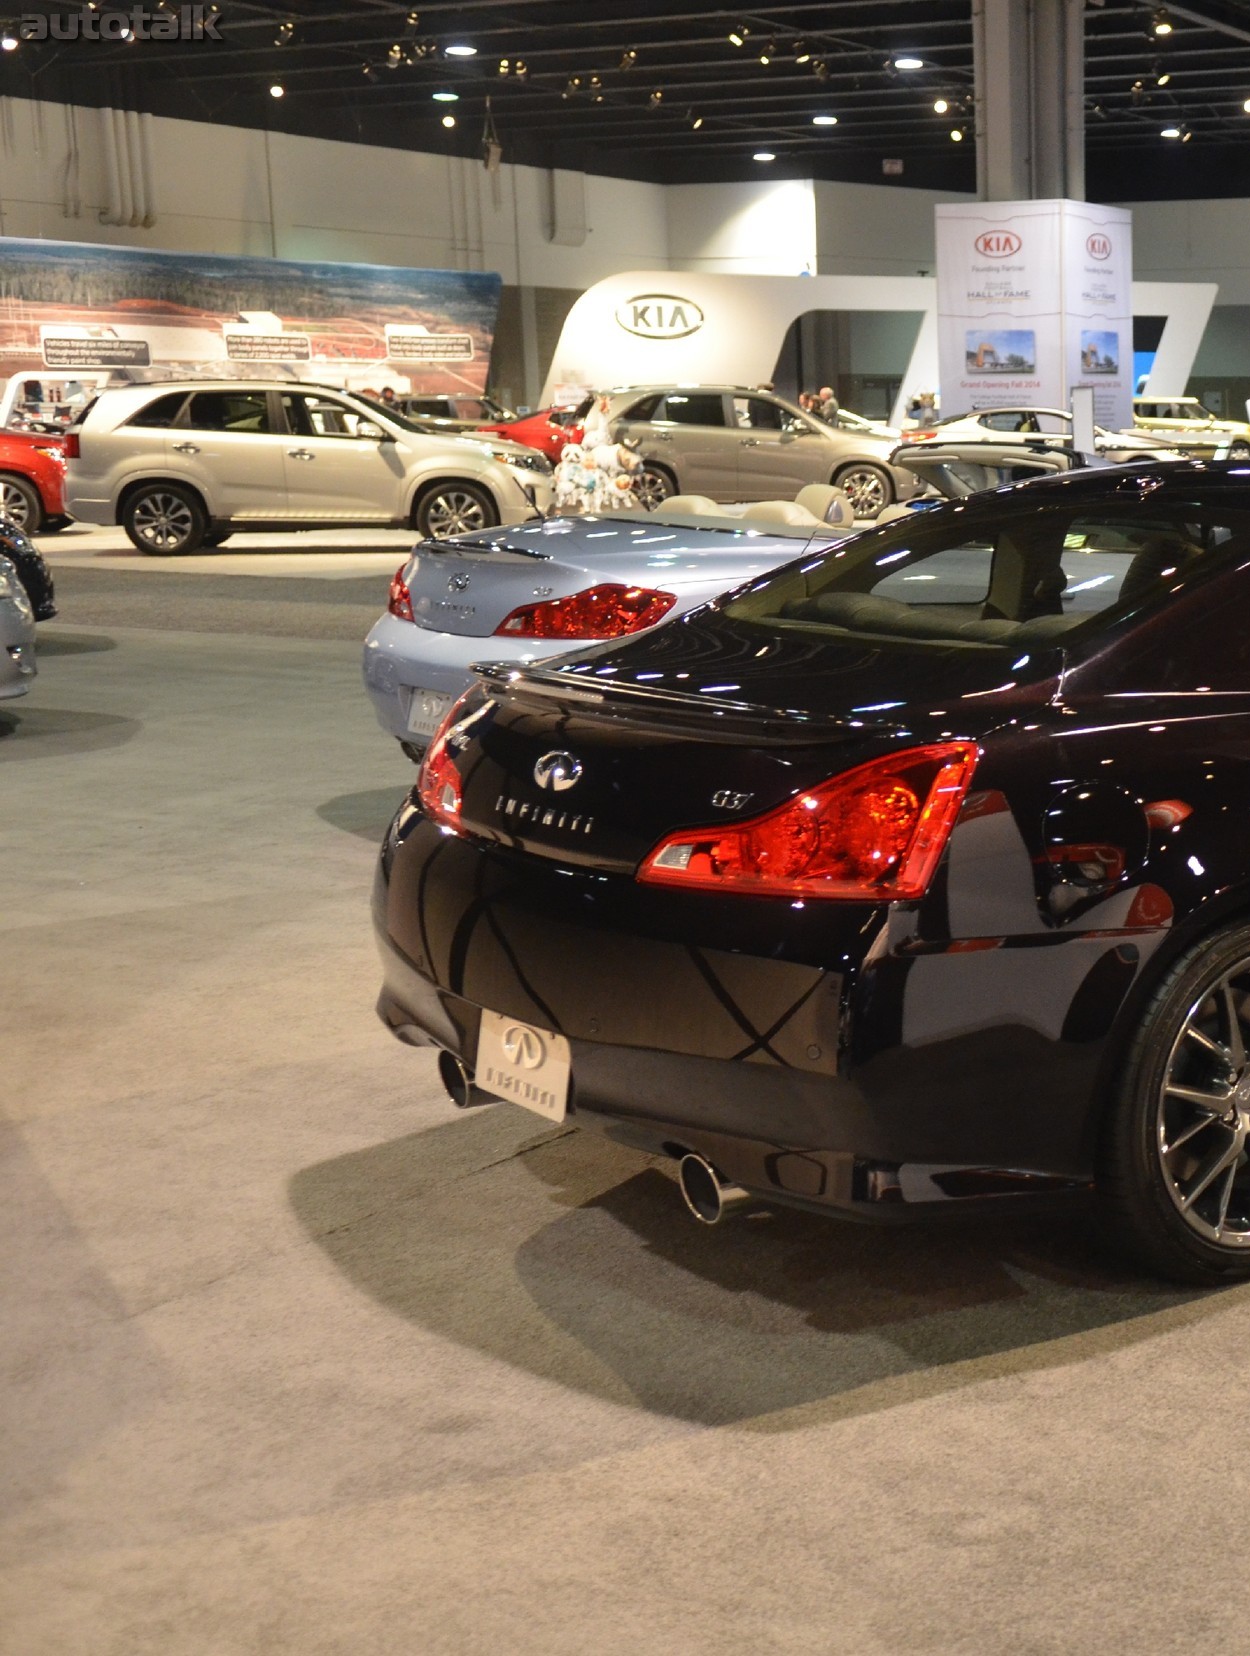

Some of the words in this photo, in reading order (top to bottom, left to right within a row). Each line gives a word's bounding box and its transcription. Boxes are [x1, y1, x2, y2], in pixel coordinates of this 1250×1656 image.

[983, 236, 1014, 251] KIA
[1091, 240, 1108, 253] KIA
[633, 306, 688, 327] KIA
[983, 381, 1009, 389] Opening
[712, 790, 755, 810] G37
[495, 795, 594, 833] INFINITI
